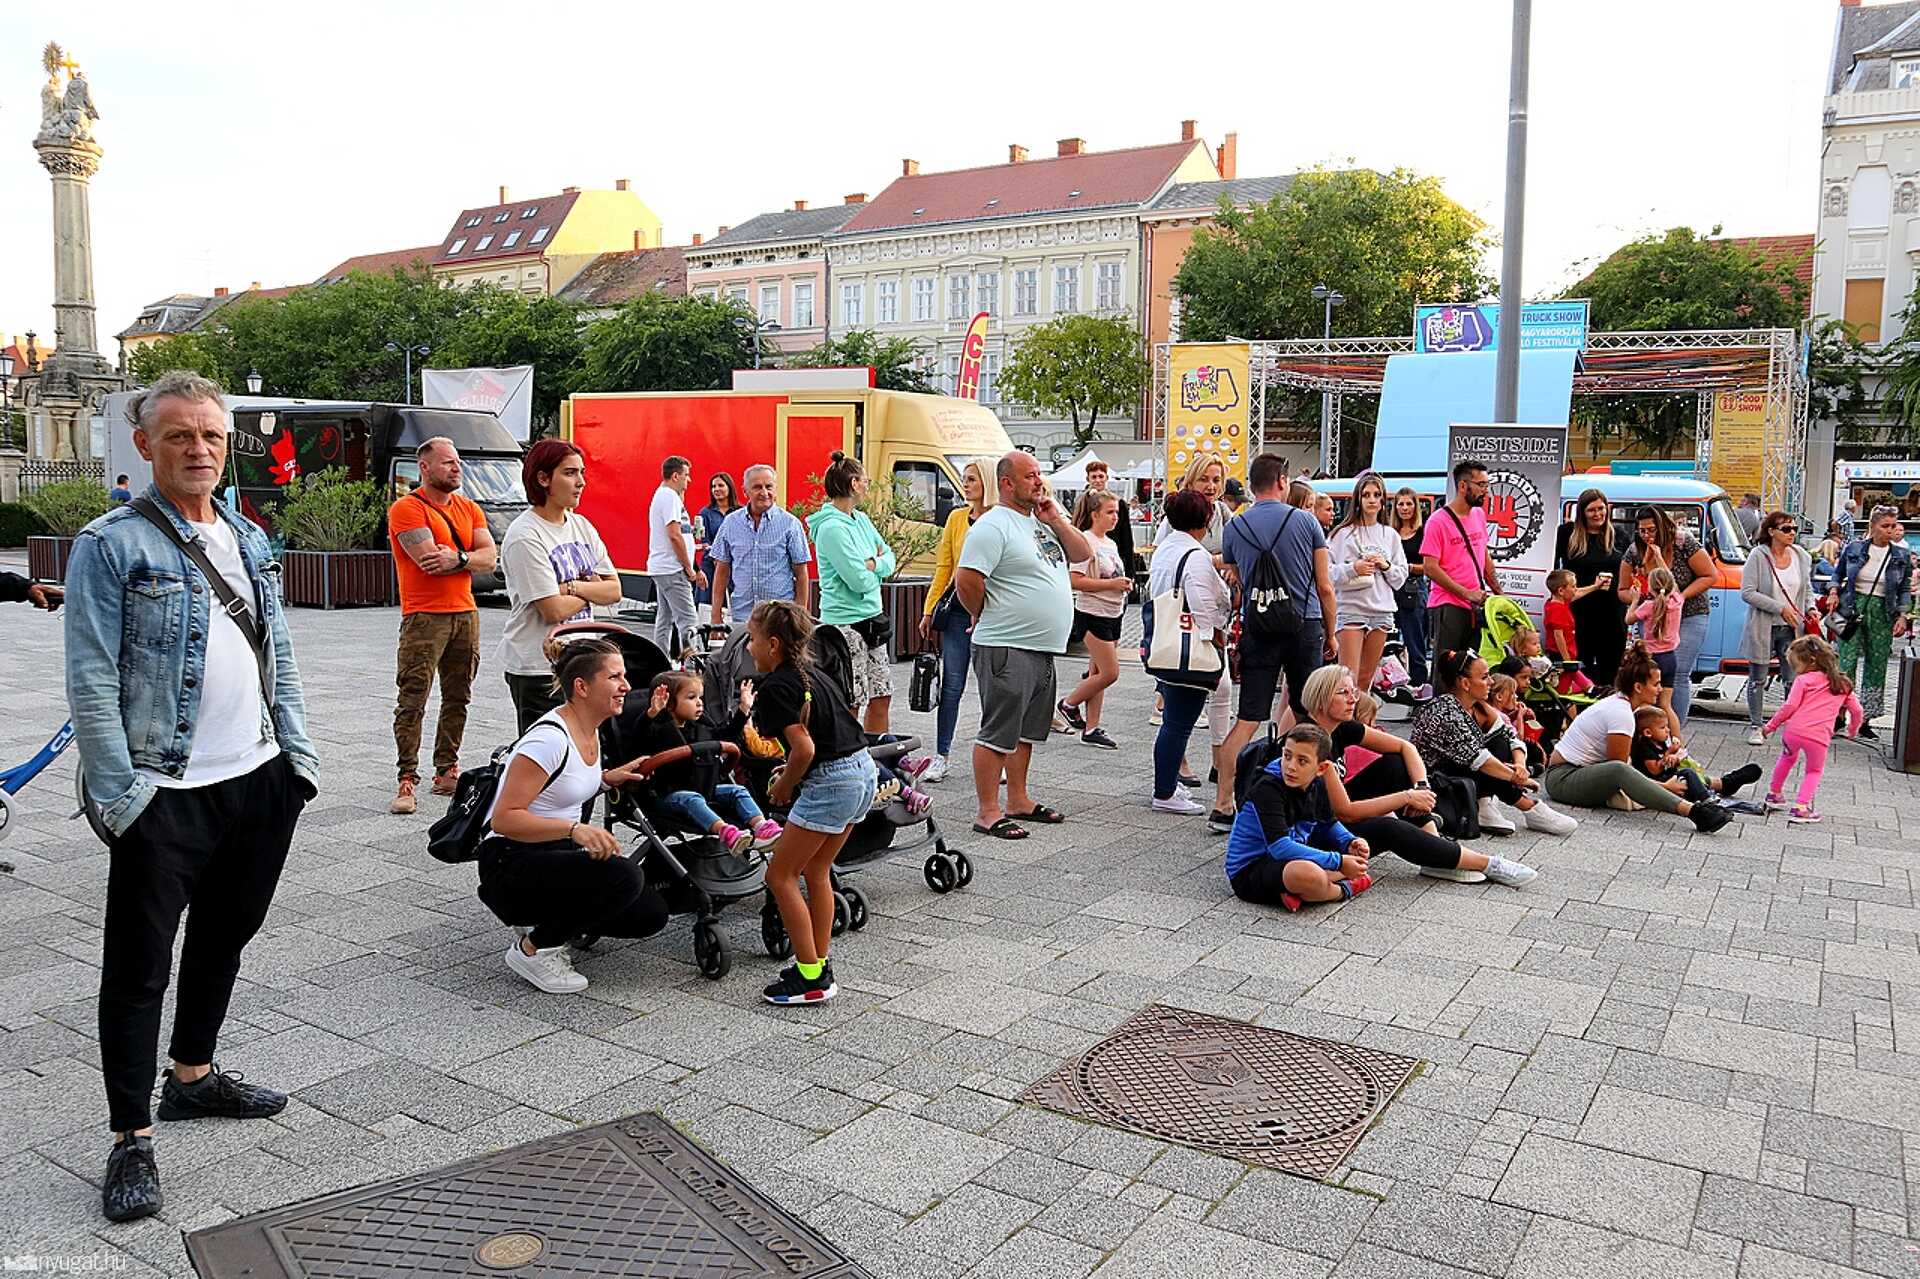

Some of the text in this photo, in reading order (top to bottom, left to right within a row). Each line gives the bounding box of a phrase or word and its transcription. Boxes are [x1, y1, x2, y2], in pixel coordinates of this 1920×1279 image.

[1521, 311, 1582, 323] TRUCK SHOW
[1455, 436, 1559, 453] WESTSIDE
[1501, 454, 1558, 463] SCHOOL
[1488, 471, 1541, 506] STSIDE
[1179, 614, 1195, 631] 9
